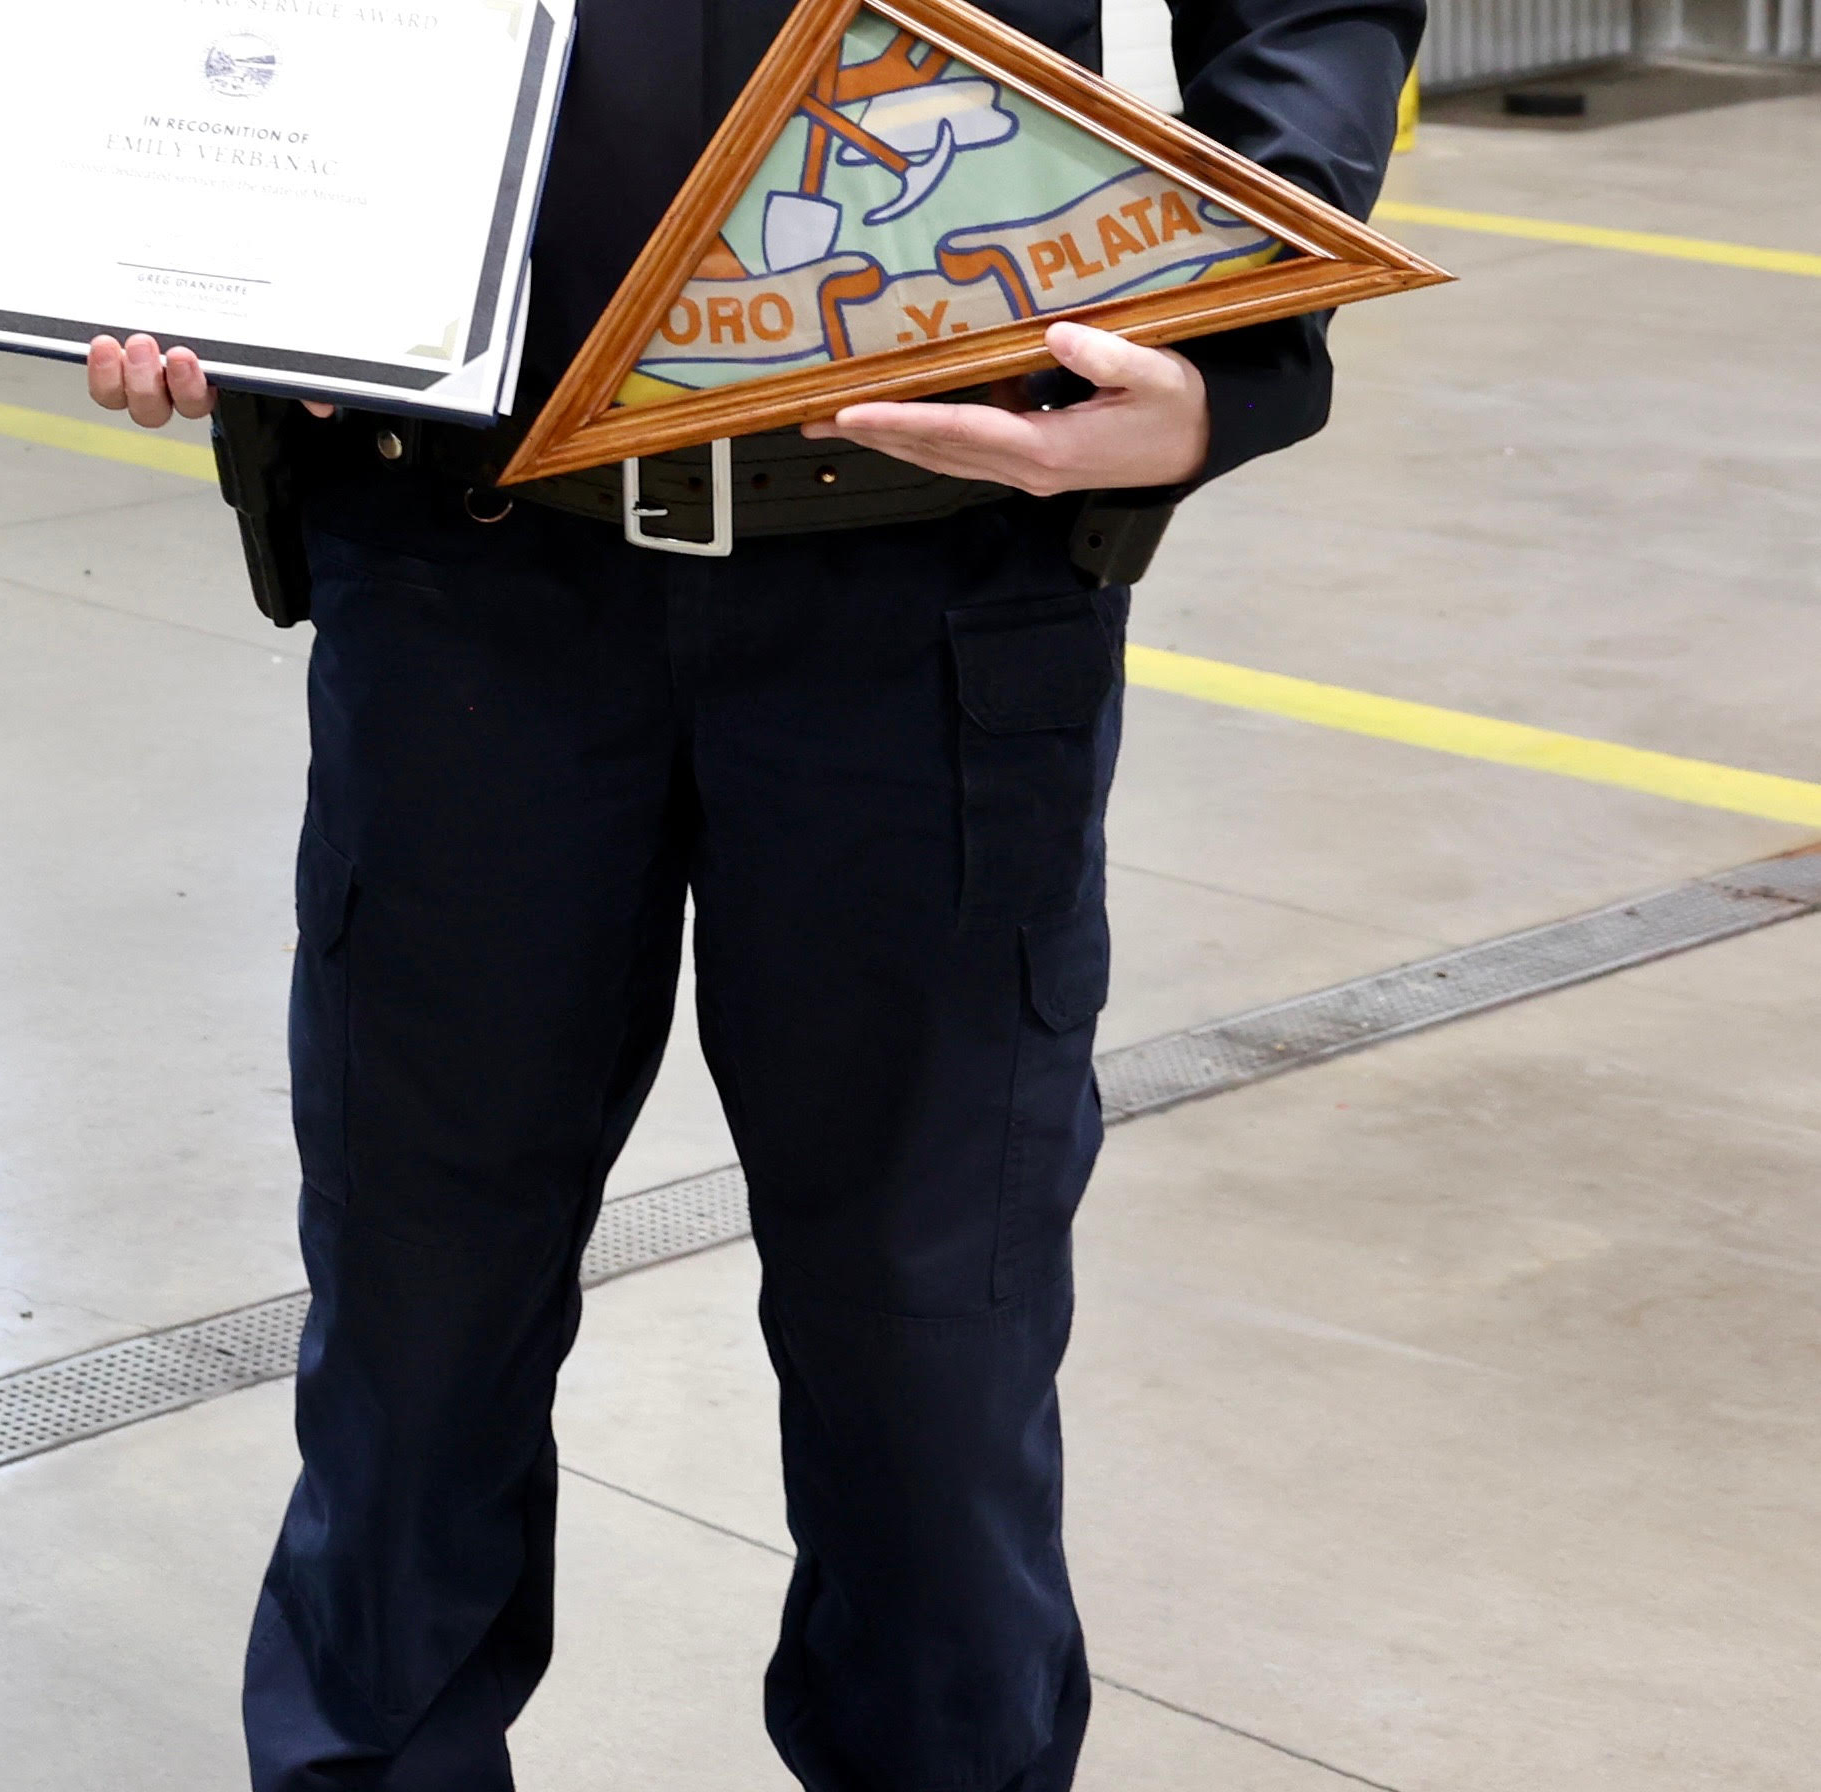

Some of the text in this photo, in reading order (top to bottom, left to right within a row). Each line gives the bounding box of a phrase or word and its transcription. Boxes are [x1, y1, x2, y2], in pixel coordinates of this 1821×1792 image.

[355, 7, 439, 30] AWARD
[143, 115, 309, 144] IN RECOGNITION OF
[107, 133, 338, 176] EMILY VERBANAC
[138, 273, 169, 285] GREG
[661, 291, 795, 347] ORO
[1028, 189, 1201, 291] PLATA
